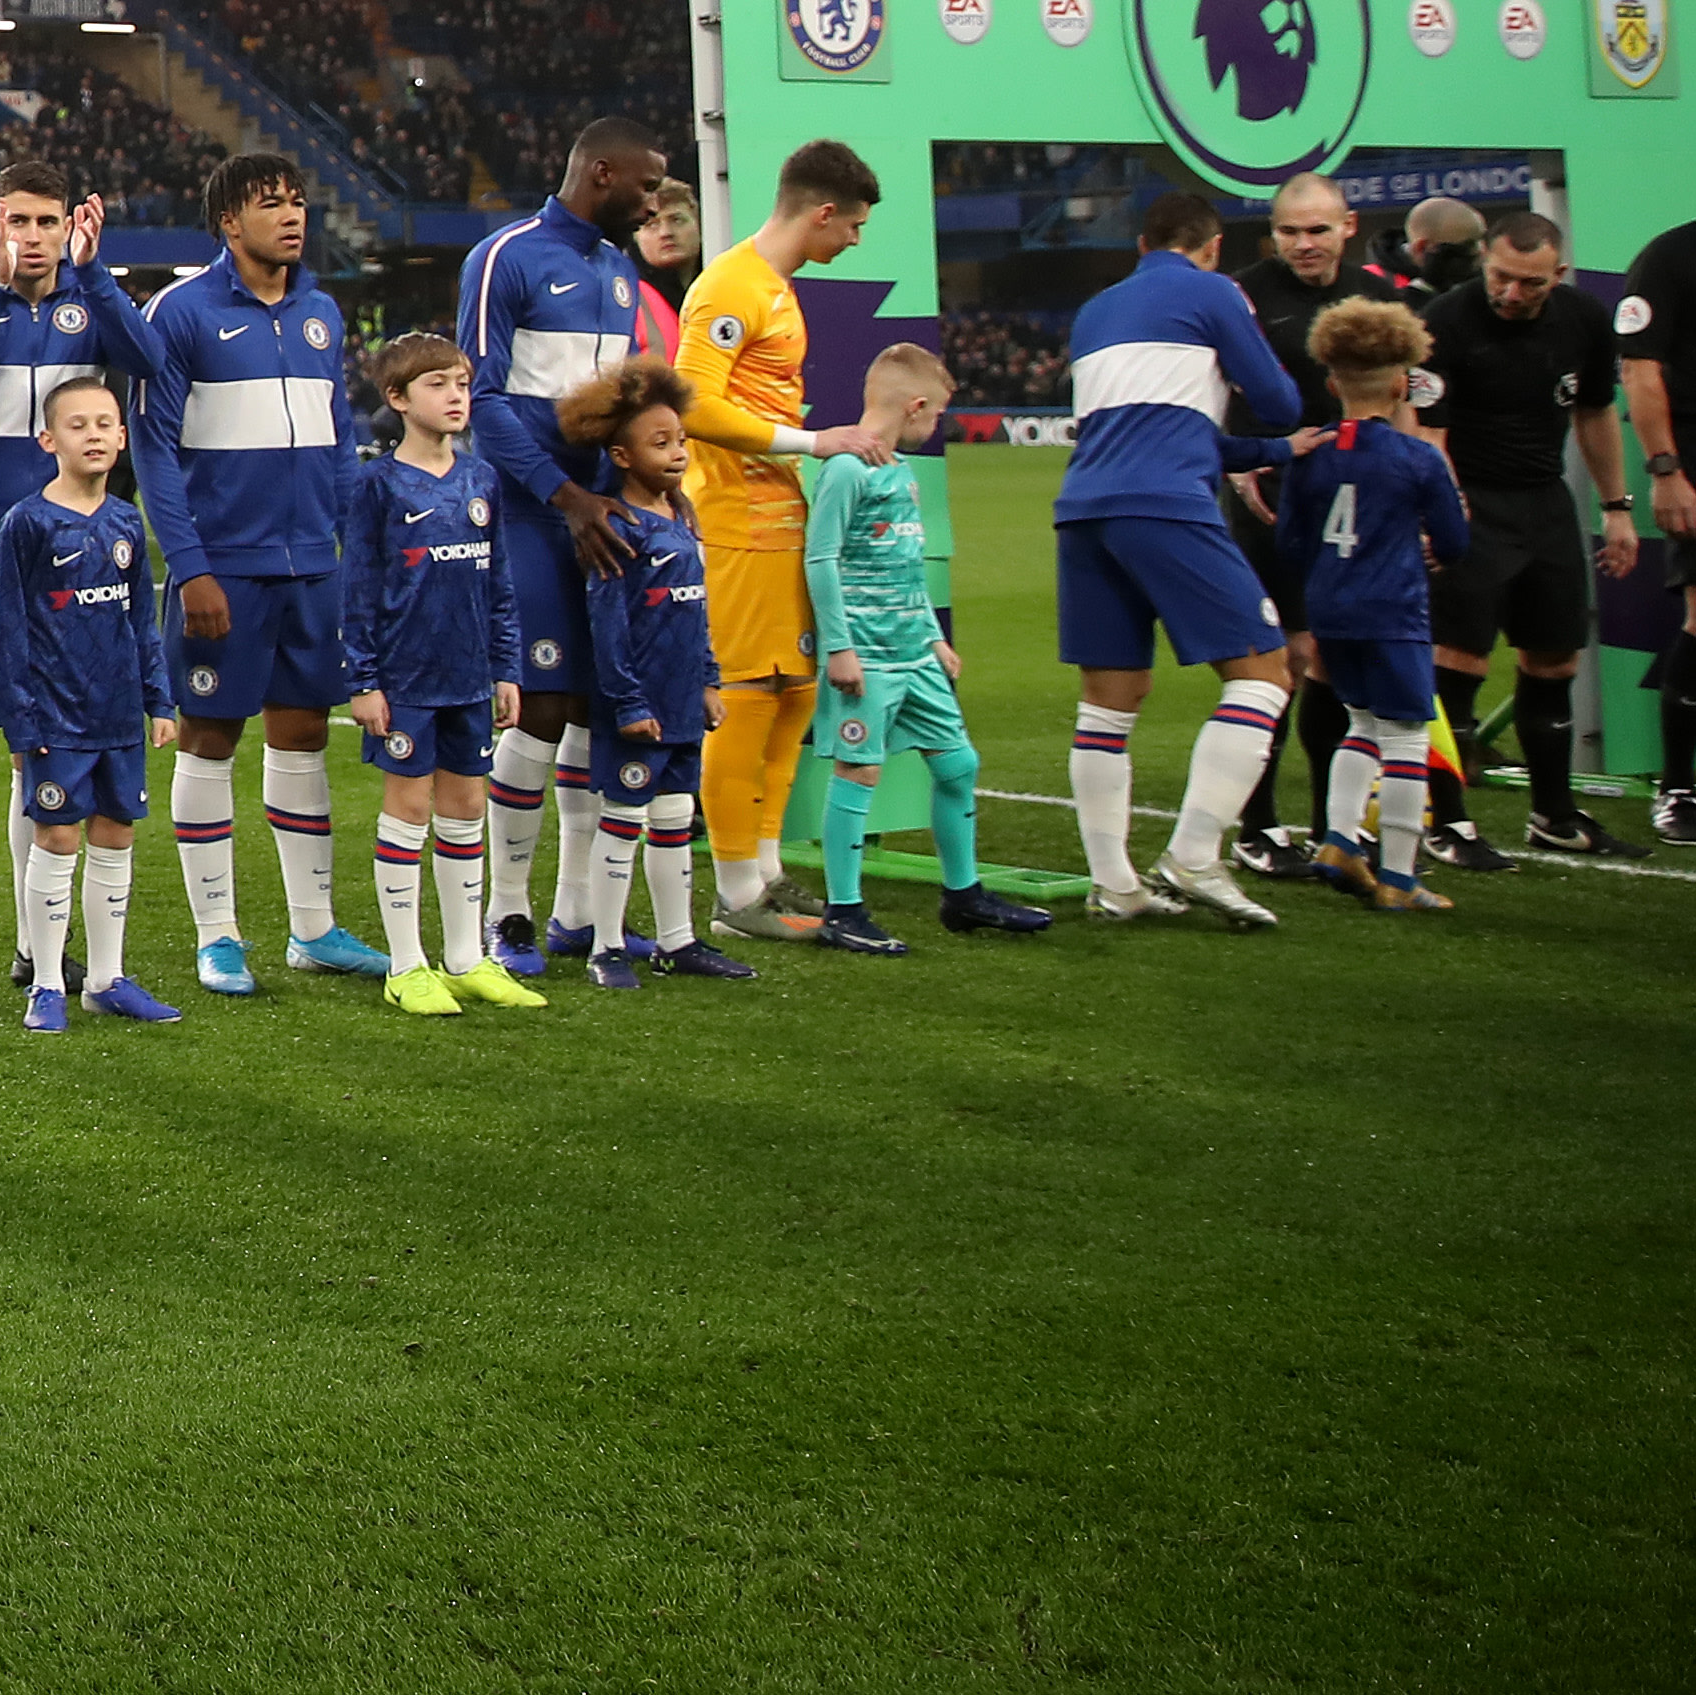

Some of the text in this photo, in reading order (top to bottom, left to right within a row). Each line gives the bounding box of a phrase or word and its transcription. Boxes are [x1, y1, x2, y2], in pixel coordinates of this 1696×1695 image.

[944, 13, 985, 26] SPORTS
[1047, 17, 1085, 29] SPORTS
[1414, 3, 1447, 28] EA
[1505, 7, 1538, 31] EA
[1427, 164, 1531, 196] LONDO
[1001, 416, 1080, 446] YOKO
[1322, 483, 1358, 559] 4
[74, 582, 130, 606] YOKOHA
